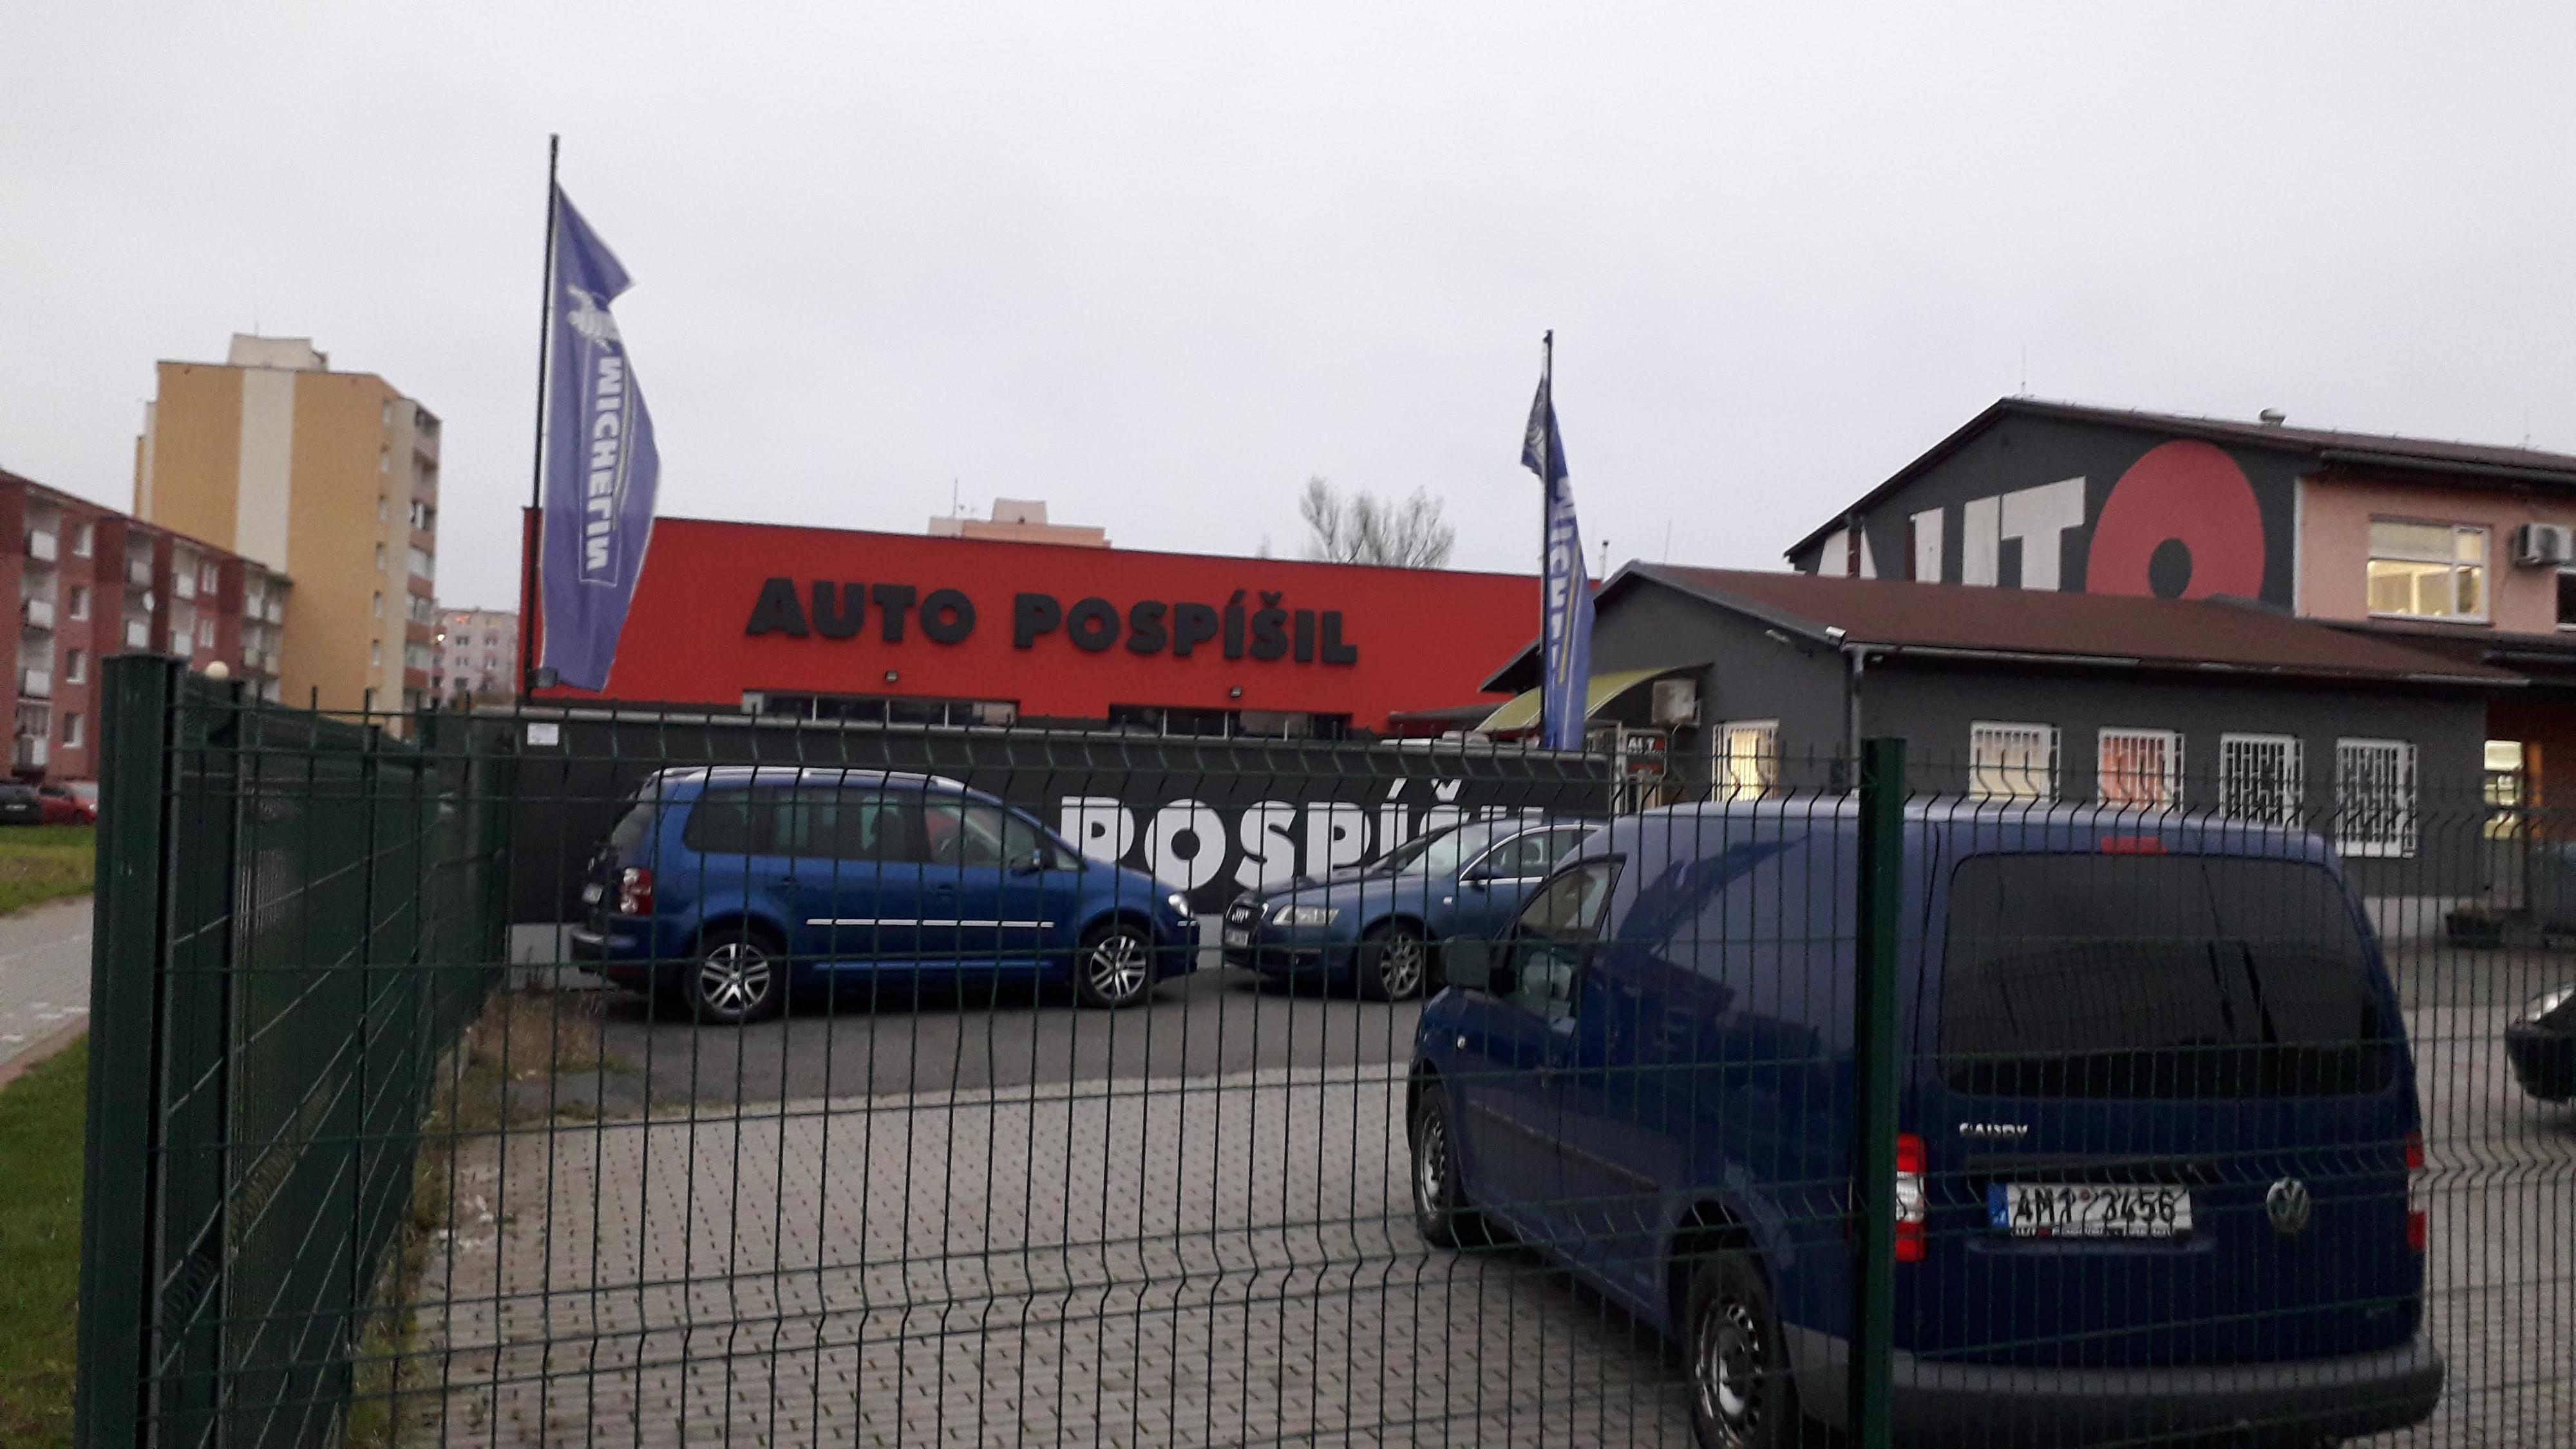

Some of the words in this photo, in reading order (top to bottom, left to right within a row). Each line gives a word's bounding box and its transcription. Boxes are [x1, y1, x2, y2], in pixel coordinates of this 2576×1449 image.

[744, 577, 977, 645] AUTO
[1013, 589, 1358, 664] POSPÍŠIL
[1061, 777, 1545, 891] POSPÍ
